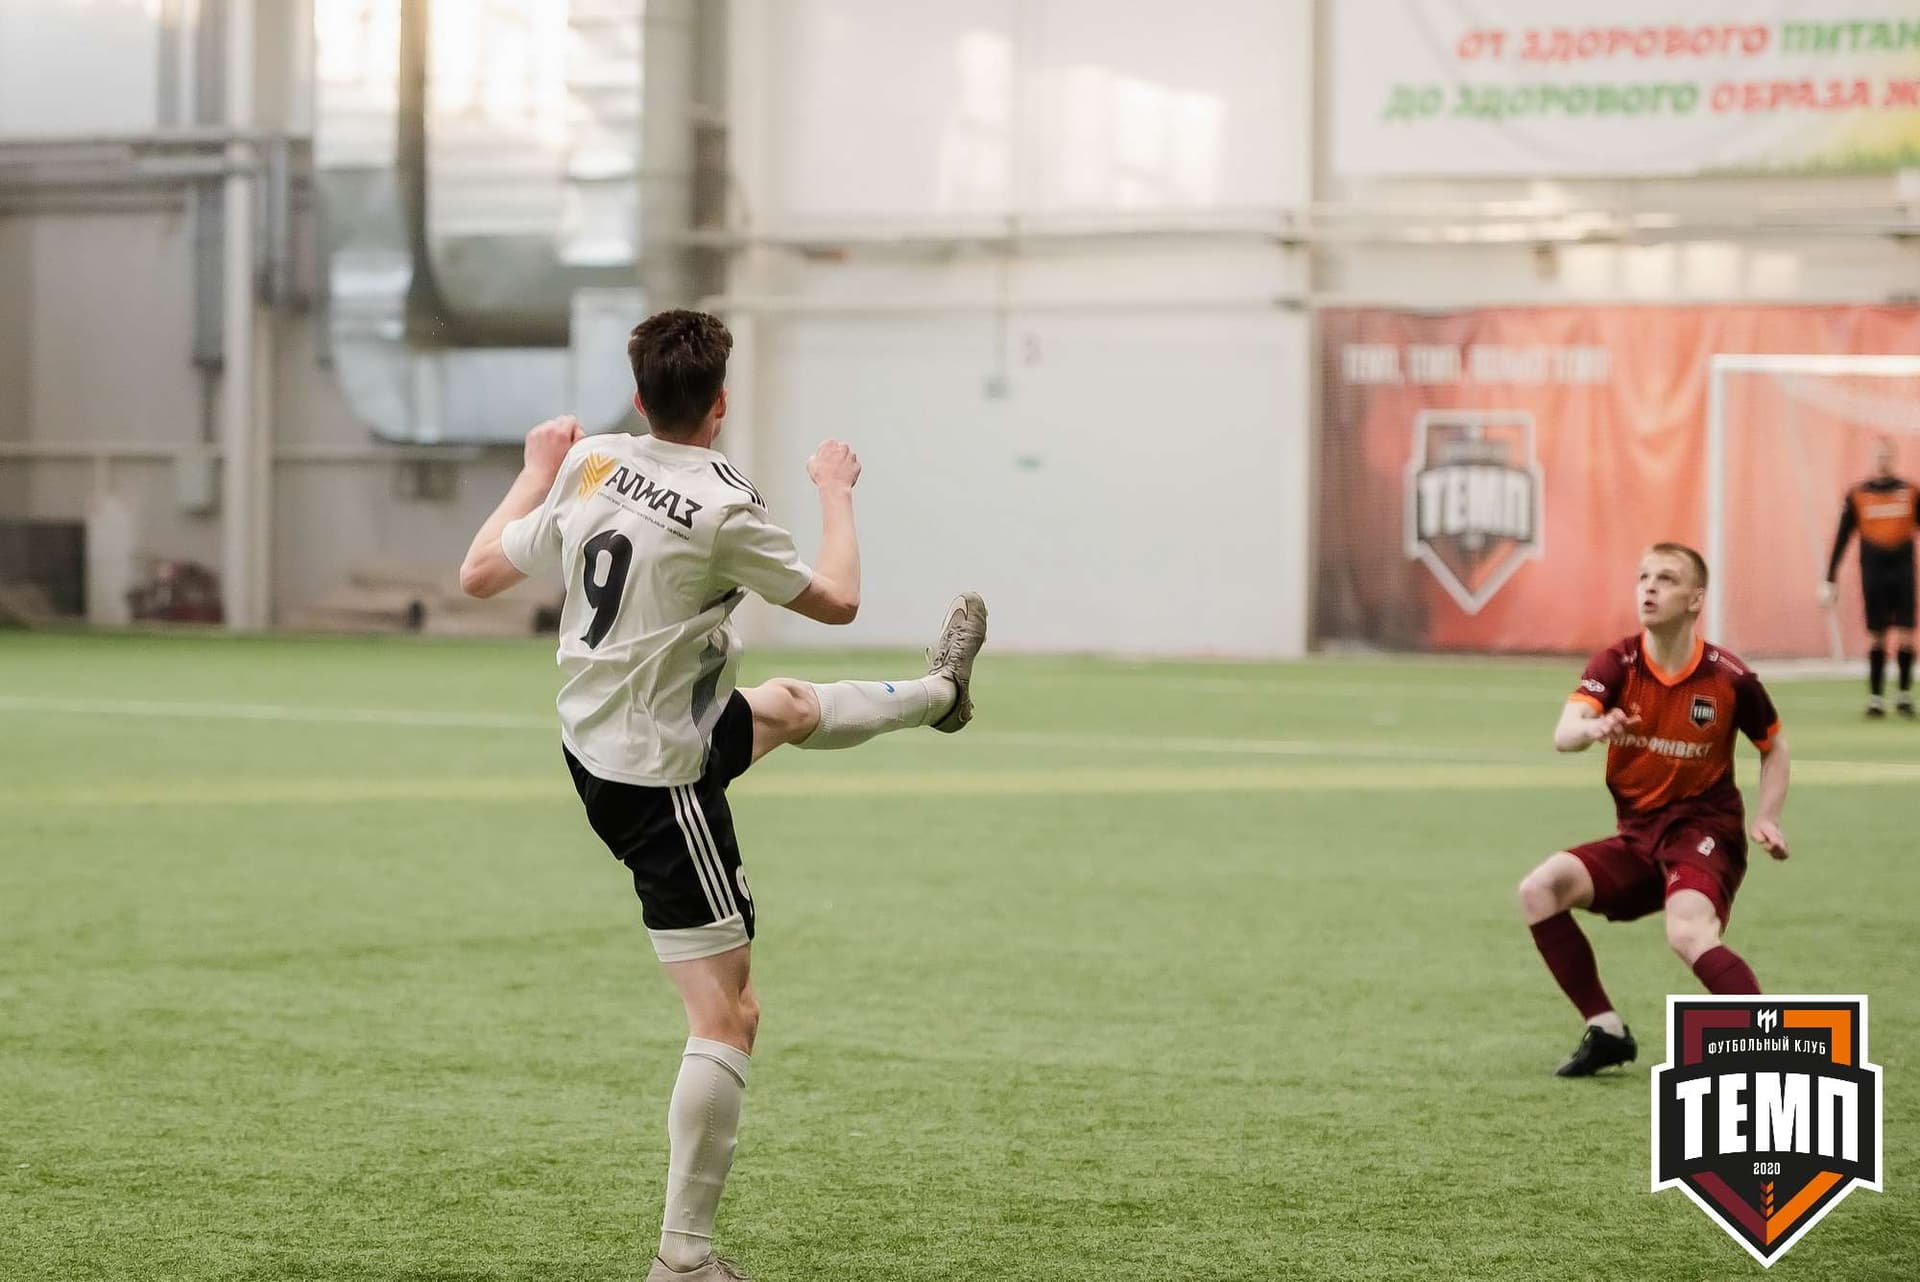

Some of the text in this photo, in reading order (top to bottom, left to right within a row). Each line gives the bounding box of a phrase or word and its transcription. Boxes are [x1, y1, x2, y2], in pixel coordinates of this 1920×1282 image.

[1456, 28, 1508, 61] ОТ
[1519, 24, 1770, 64] ЗДОРОВОГО
[1384, 83, 1443, 121] ДО
[1452, 82, 1697, 120] ЗДОРОВОГО
[1709, 79, 1870, 113] ОБРАЗА
[605, 466, 703, 530] АЛМАЗ
[1418, 467, 1531, 538] ТЕМП
[580, 530, 633, 650] 9
[1693, 704, 1716, 721] ТЕМП
